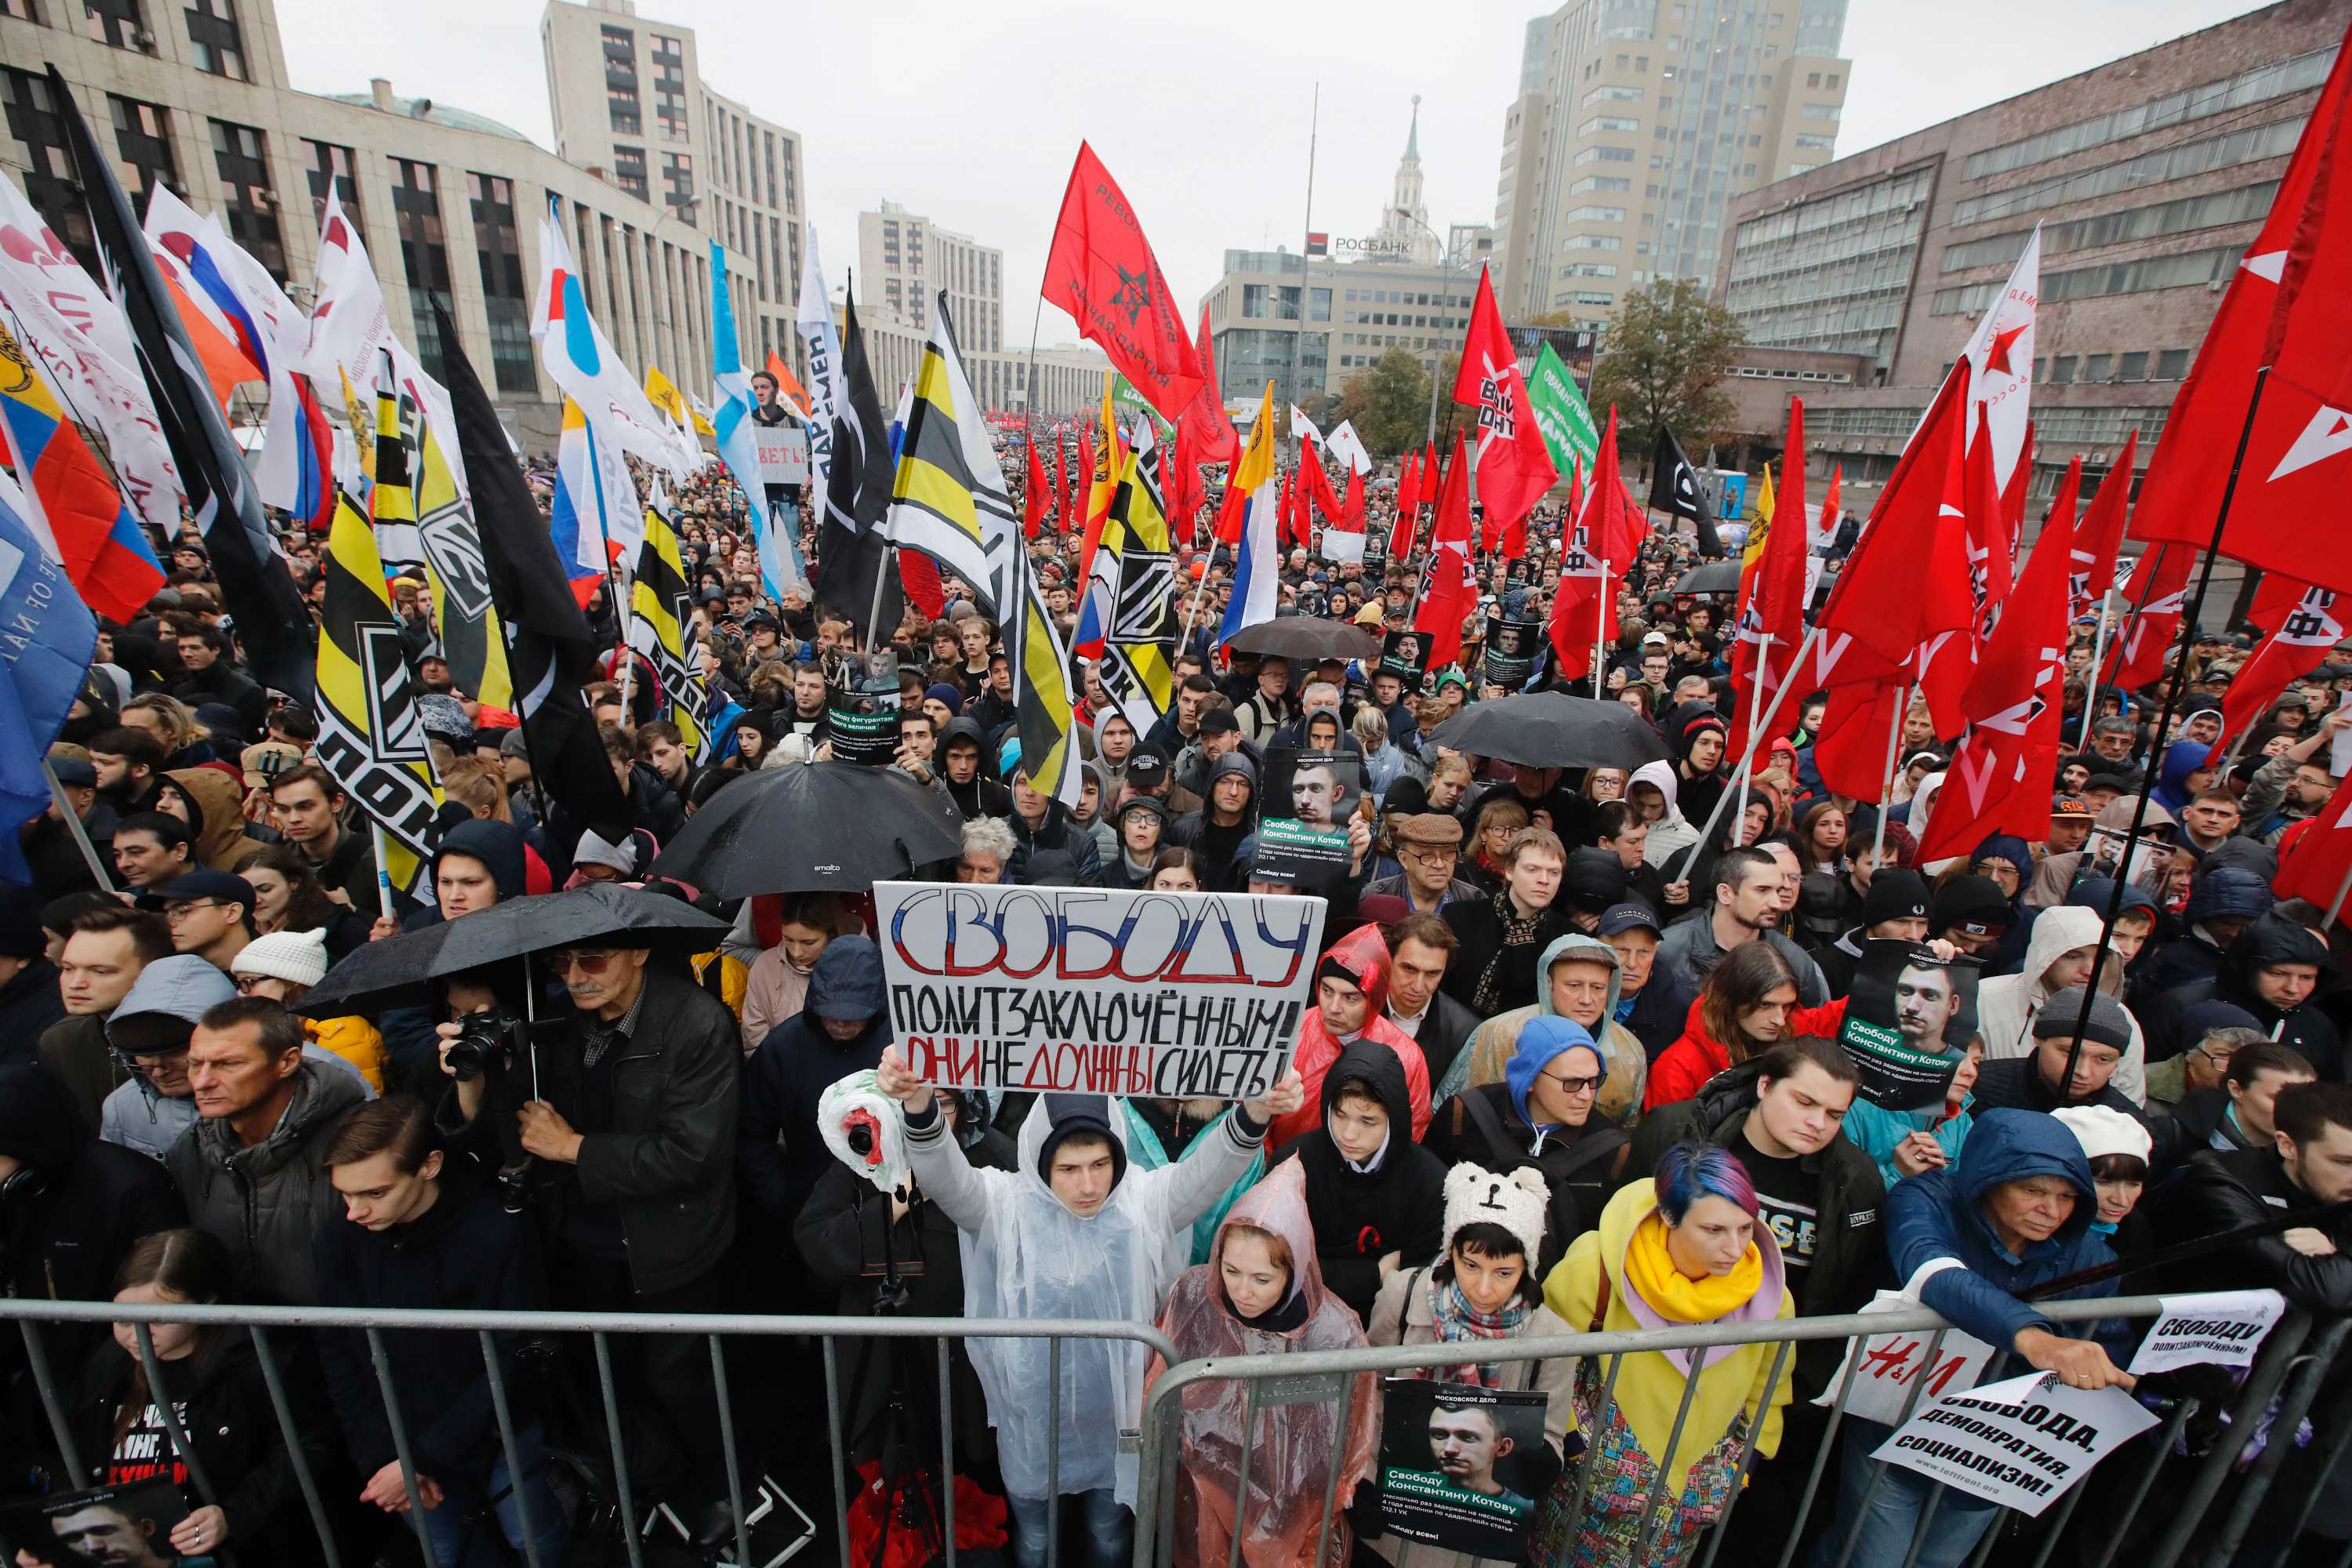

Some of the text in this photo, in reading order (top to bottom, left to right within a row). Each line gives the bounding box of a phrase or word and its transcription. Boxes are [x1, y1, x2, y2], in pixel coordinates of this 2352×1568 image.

[1336, 238, 1409, 252] РОСБАНК
[1116, 335, 1171, 388] ПАРТИЯ
[758, 448, 807, 464] ВЕТЫ
[829, 709, 894, 724] Свободу фигурантам
[829, 717, 848, 728] Нового
[1264, 819, 1300, 832] Свободу
[1263, 829, 1345, 846] Константину Котову
[1256, 868, 1279, 877] Свободу
[891, 888, 1313, 987] СВОБОДУ
[891, 985, 1301, 1050] ПОЛИТЗАКЛЮЧЁННЫМ!
[1850, 1021, 1898, 1046] Свободу
[1846, 1031, 1951, 1068] Константину Котову
[907, 1036, 1290, 1098] ОНИ НЕ ДОЛЖНЫ СИДЕТЬ!
[1857, 1058, 1882, 1073] колонии
[1871, 1056, 1882, 1065] раз
[1882, 1061, 1912, 1074] задержан
[1862, 1083, 1882, 1098] всем!
[2157, 1319, 2264, 1341] СВОБОДУ
[1859, 1336, 1967, 1398] H&M
[1918, 1409, 2071, 1479] ДЕМОКРАТИЯ,
[1895, 1435, 2053, 1497] СОЦИАЛИЗМ!
[1915, 1457, 2001, 1495] www.leftfront.org
[1388, 1470, 1443, 1487] Свободу
[1383, 1493, 1419, 1505] Несколько
[1433, 1502, 1467, 1514] задержан
[1388, 1480, 1516, 1515] Константину Котову
[1382, 1506, 1398, 1515] 212.1
[1404, 1504, 1433, 1515] колонии
[1444, 1512, 1489, 1526] «дадинской»
[1490, 1522, 1513, 1532] статье
[1388, 1523, 1439, 1540] ободу всем!
